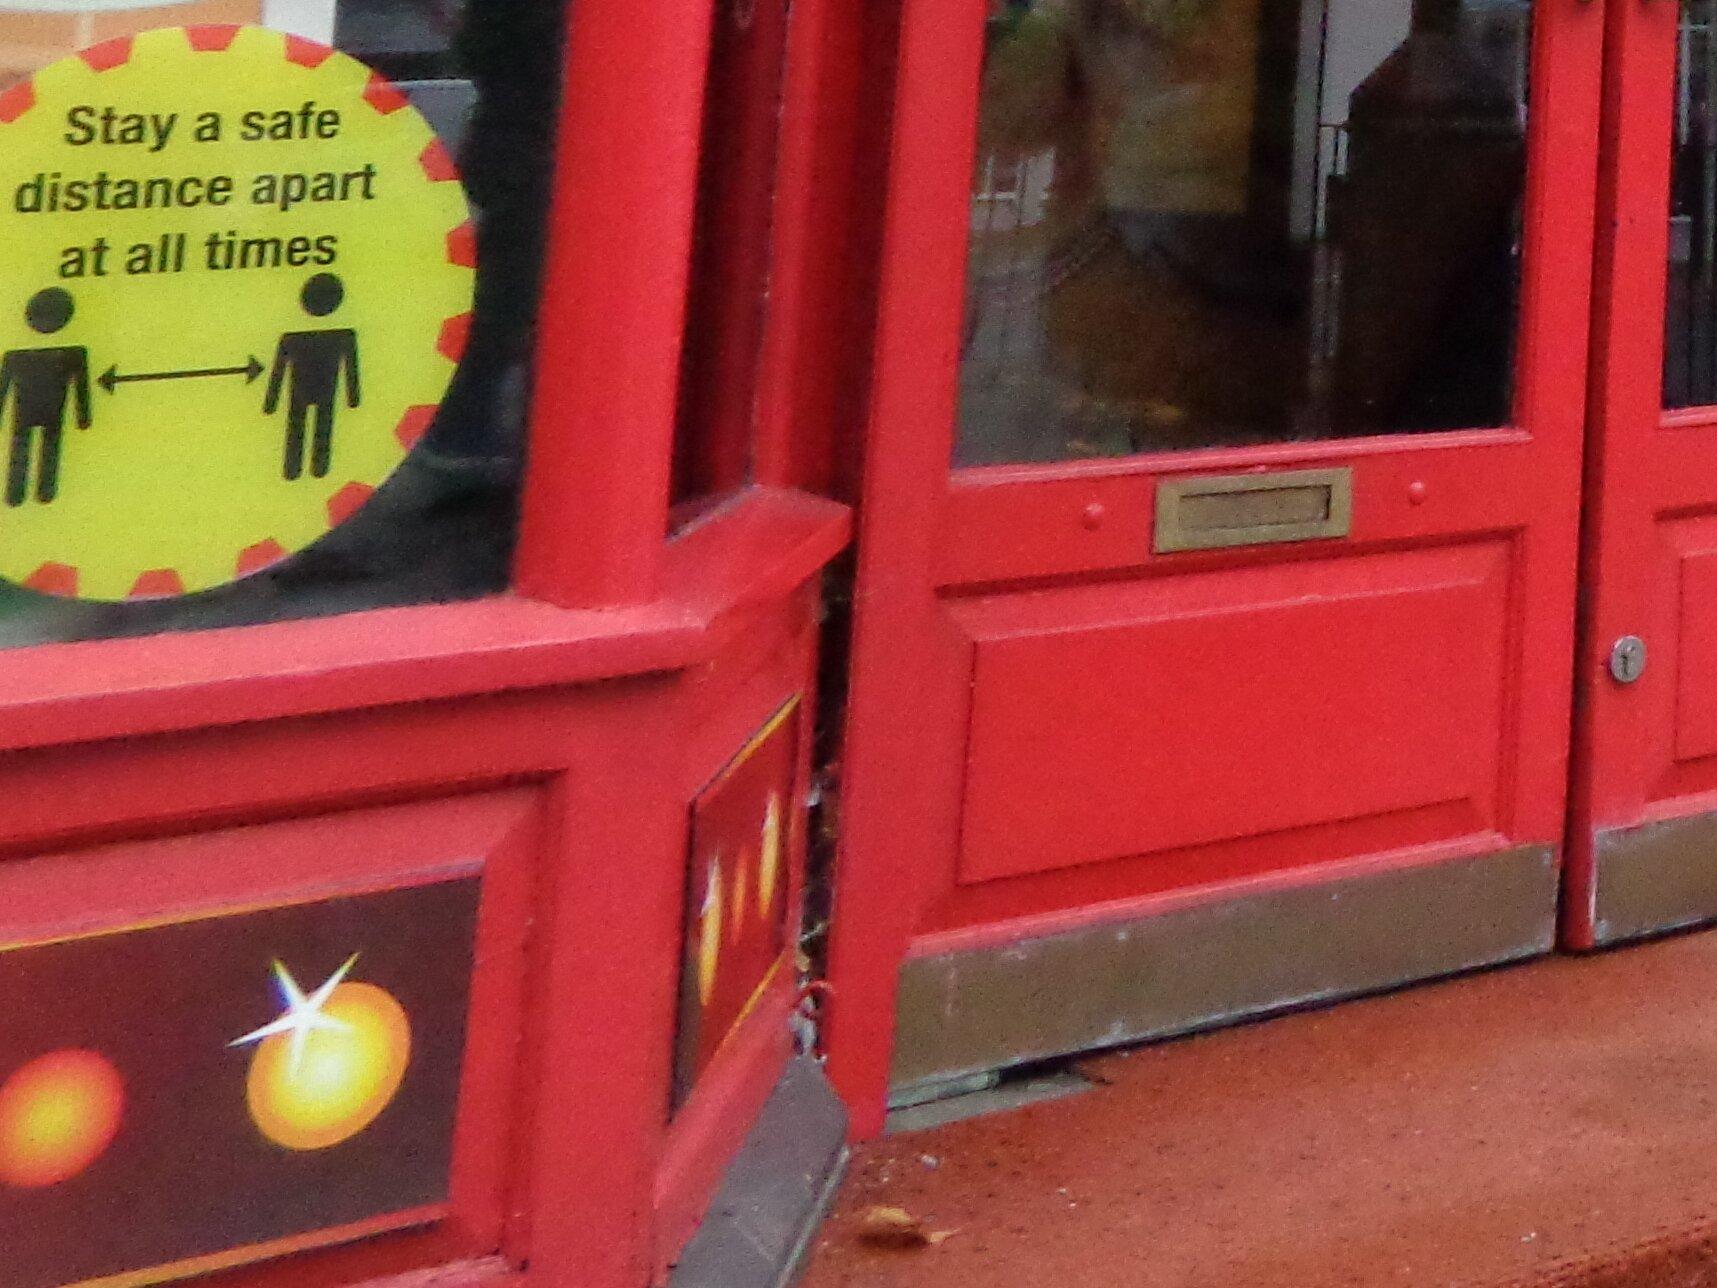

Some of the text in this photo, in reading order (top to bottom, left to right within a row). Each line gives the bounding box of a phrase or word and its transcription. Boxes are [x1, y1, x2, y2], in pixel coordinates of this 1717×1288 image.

[64, 101, 341, 153] Stay a safe
[13, 163, 378, 214] distance apart
[58, 231, 339, 279] at all times
